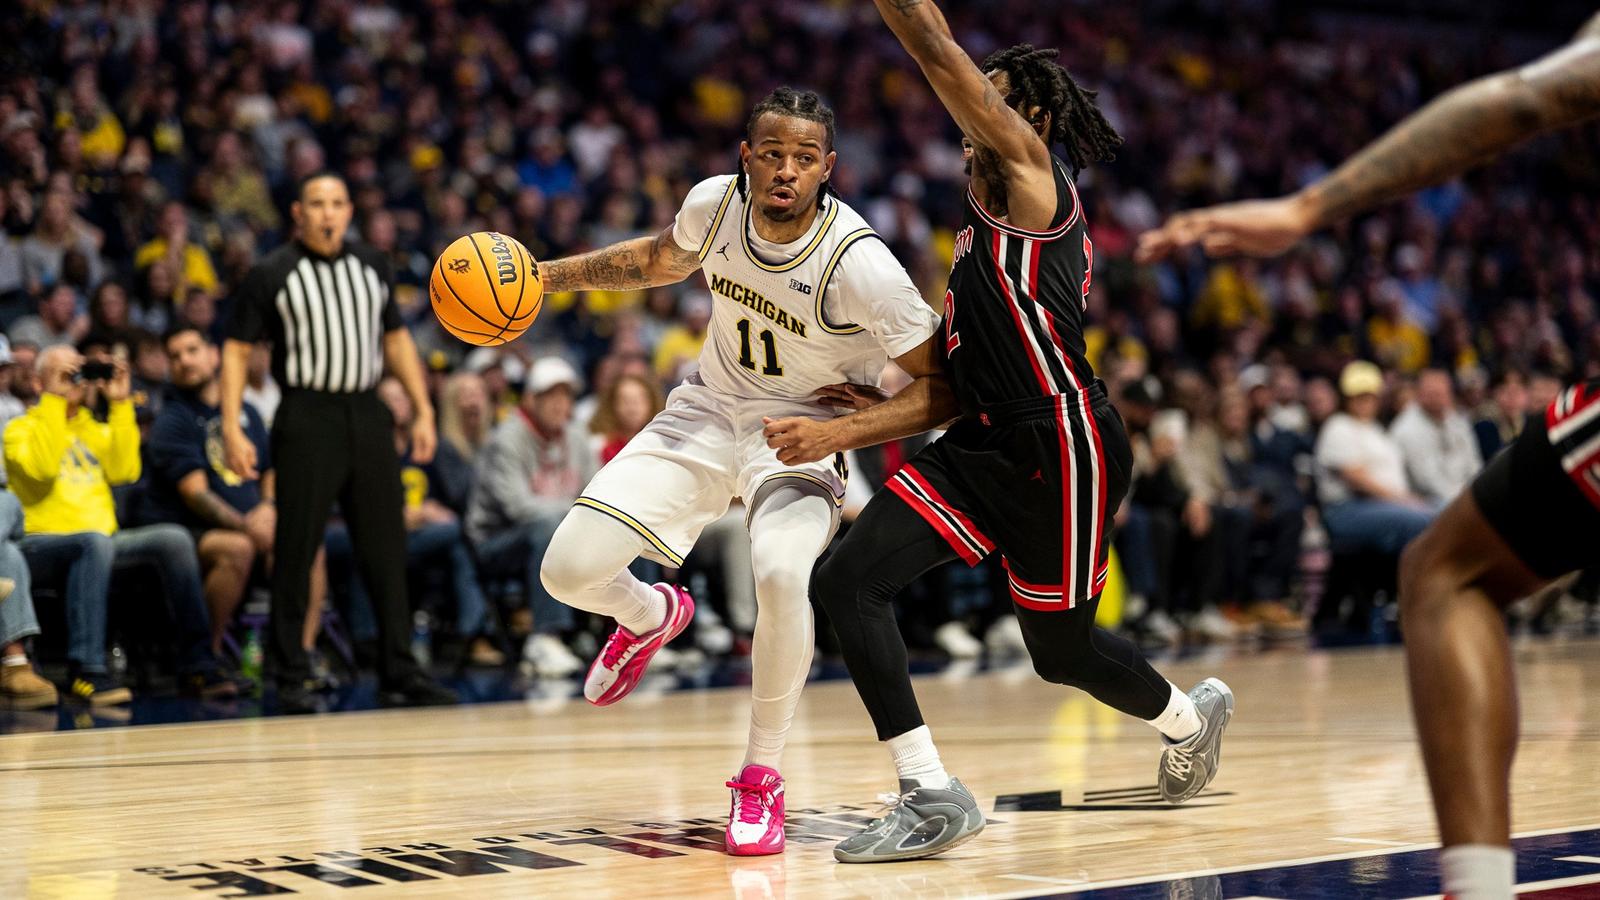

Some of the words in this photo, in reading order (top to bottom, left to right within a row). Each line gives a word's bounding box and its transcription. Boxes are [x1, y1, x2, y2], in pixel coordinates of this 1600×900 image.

[711, 273, 807, 339] MICHIGAN
[736, 317, 783, 376] 11
[132, 842, 452, 875] RENTALS
[472, 827, 607, 845] AND
[160, 845, 588, 898] MILE
